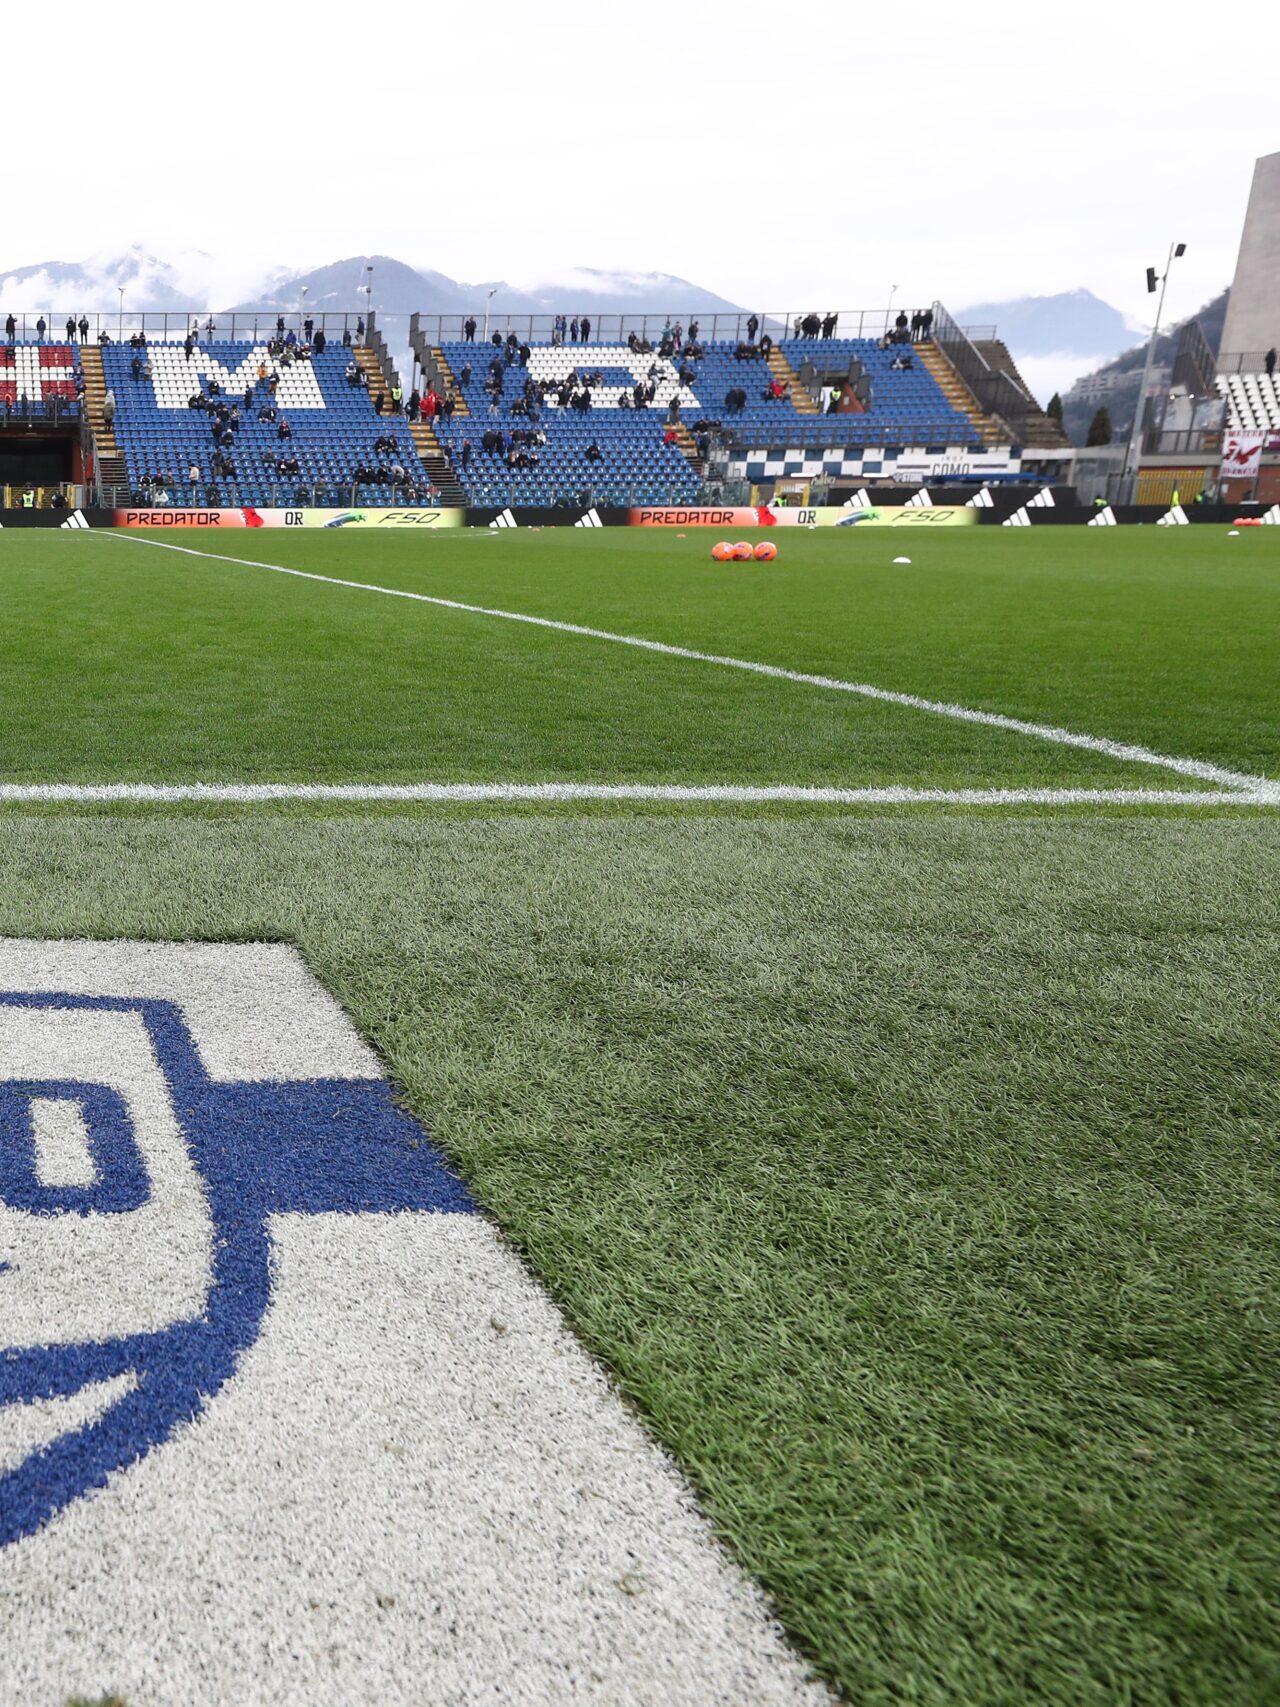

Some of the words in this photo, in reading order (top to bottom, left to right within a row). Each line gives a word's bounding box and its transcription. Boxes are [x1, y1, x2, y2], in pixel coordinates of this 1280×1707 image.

[932, 463, 970, 476] COMO
[126, 512, 220, 525] PREDATOR
[285, 512, 303, 525] OR
[640, 511, 734, 524] PREDATOR
[798, 511, 816, 524] OR
